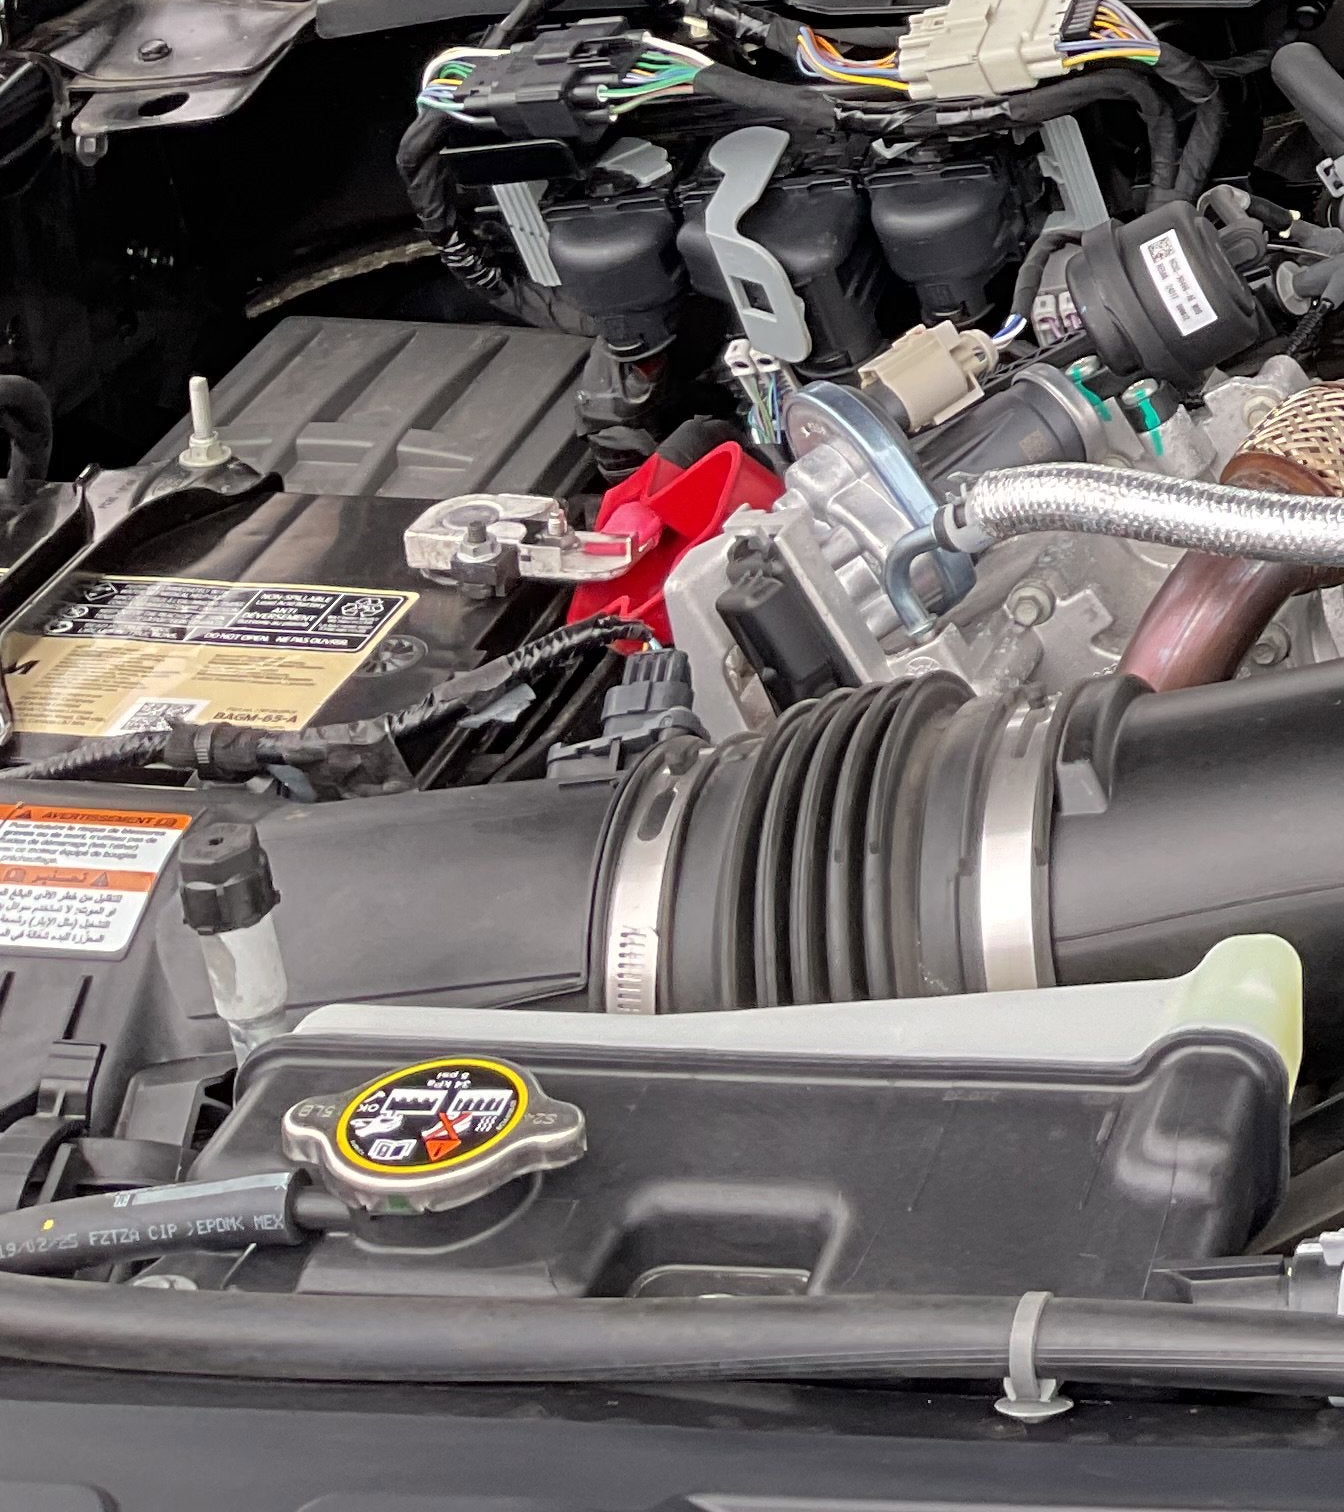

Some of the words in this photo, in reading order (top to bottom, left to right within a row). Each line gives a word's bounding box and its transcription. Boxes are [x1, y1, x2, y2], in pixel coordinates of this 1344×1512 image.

[357, 1101, 380, 1113] OK
[148, 1223, 178, 1241] CIP
[254, 1214, 286, 1231] MEX
